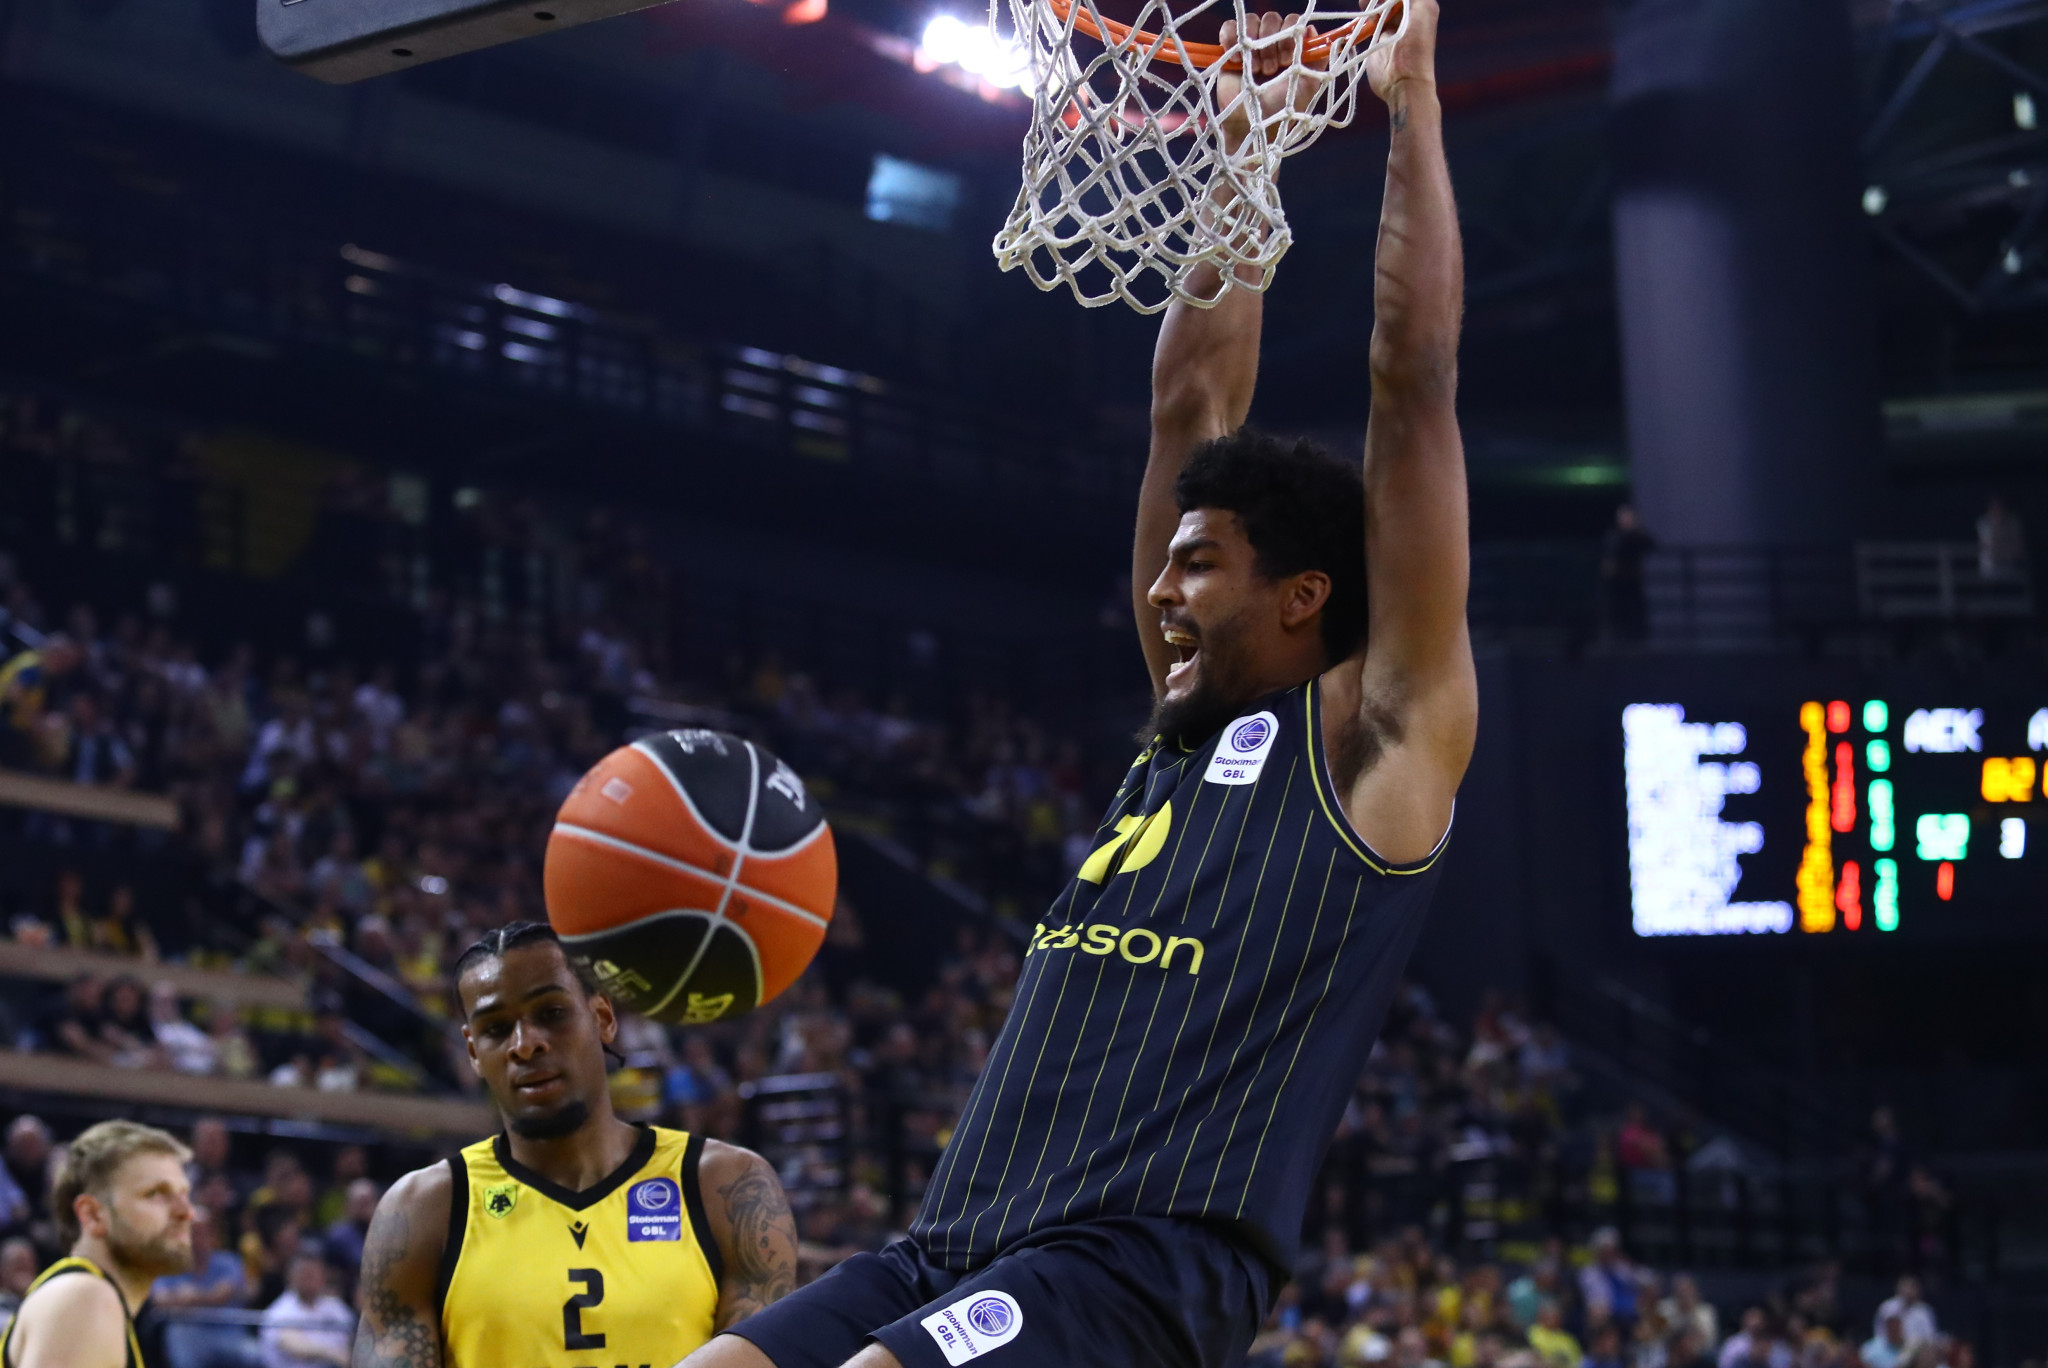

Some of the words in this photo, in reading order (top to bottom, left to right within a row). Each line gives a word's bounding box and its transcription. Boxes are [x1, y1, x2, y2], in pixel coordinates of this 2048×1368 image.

[1223, 769, 1246, 779] GBL
[641, 1226, 667, 1236] GBL
[563, 1268, 606, 1351] 2
[937, 1325, 957, 1349] GBL
[942, 1310, 978, 1355] Stoiximan
